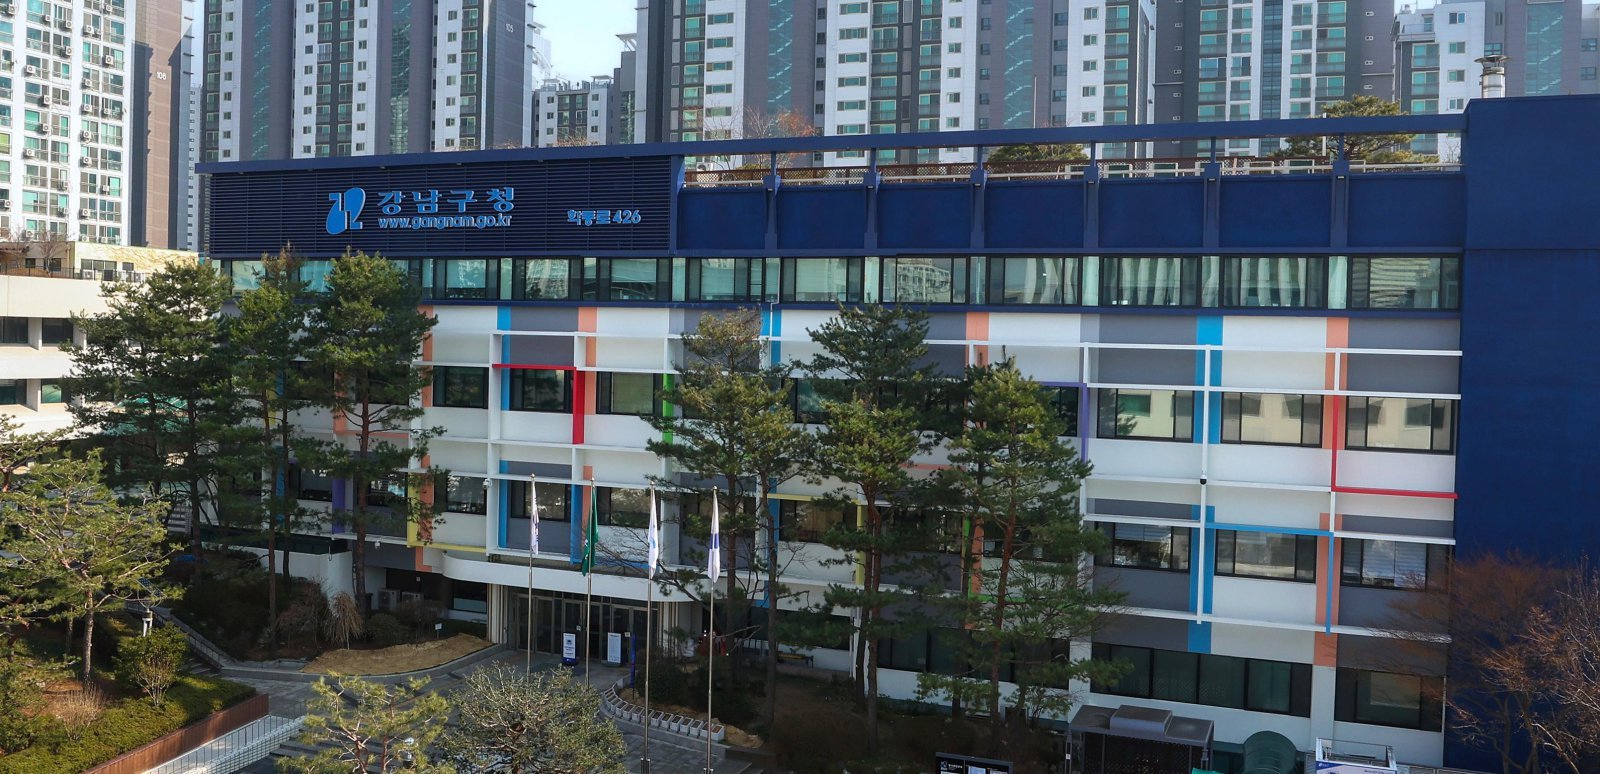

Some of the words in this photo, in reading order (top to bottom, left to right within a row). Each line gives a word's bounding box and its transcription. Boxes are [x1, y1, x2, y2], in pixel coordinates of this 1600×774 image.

[377, 187, 514, 215] 강남구청
[378, 213, 512, 230] www.gangnam.go.kr
[567, 209, 611, 226] 학동로
[612, 209, 642, 224] 426
